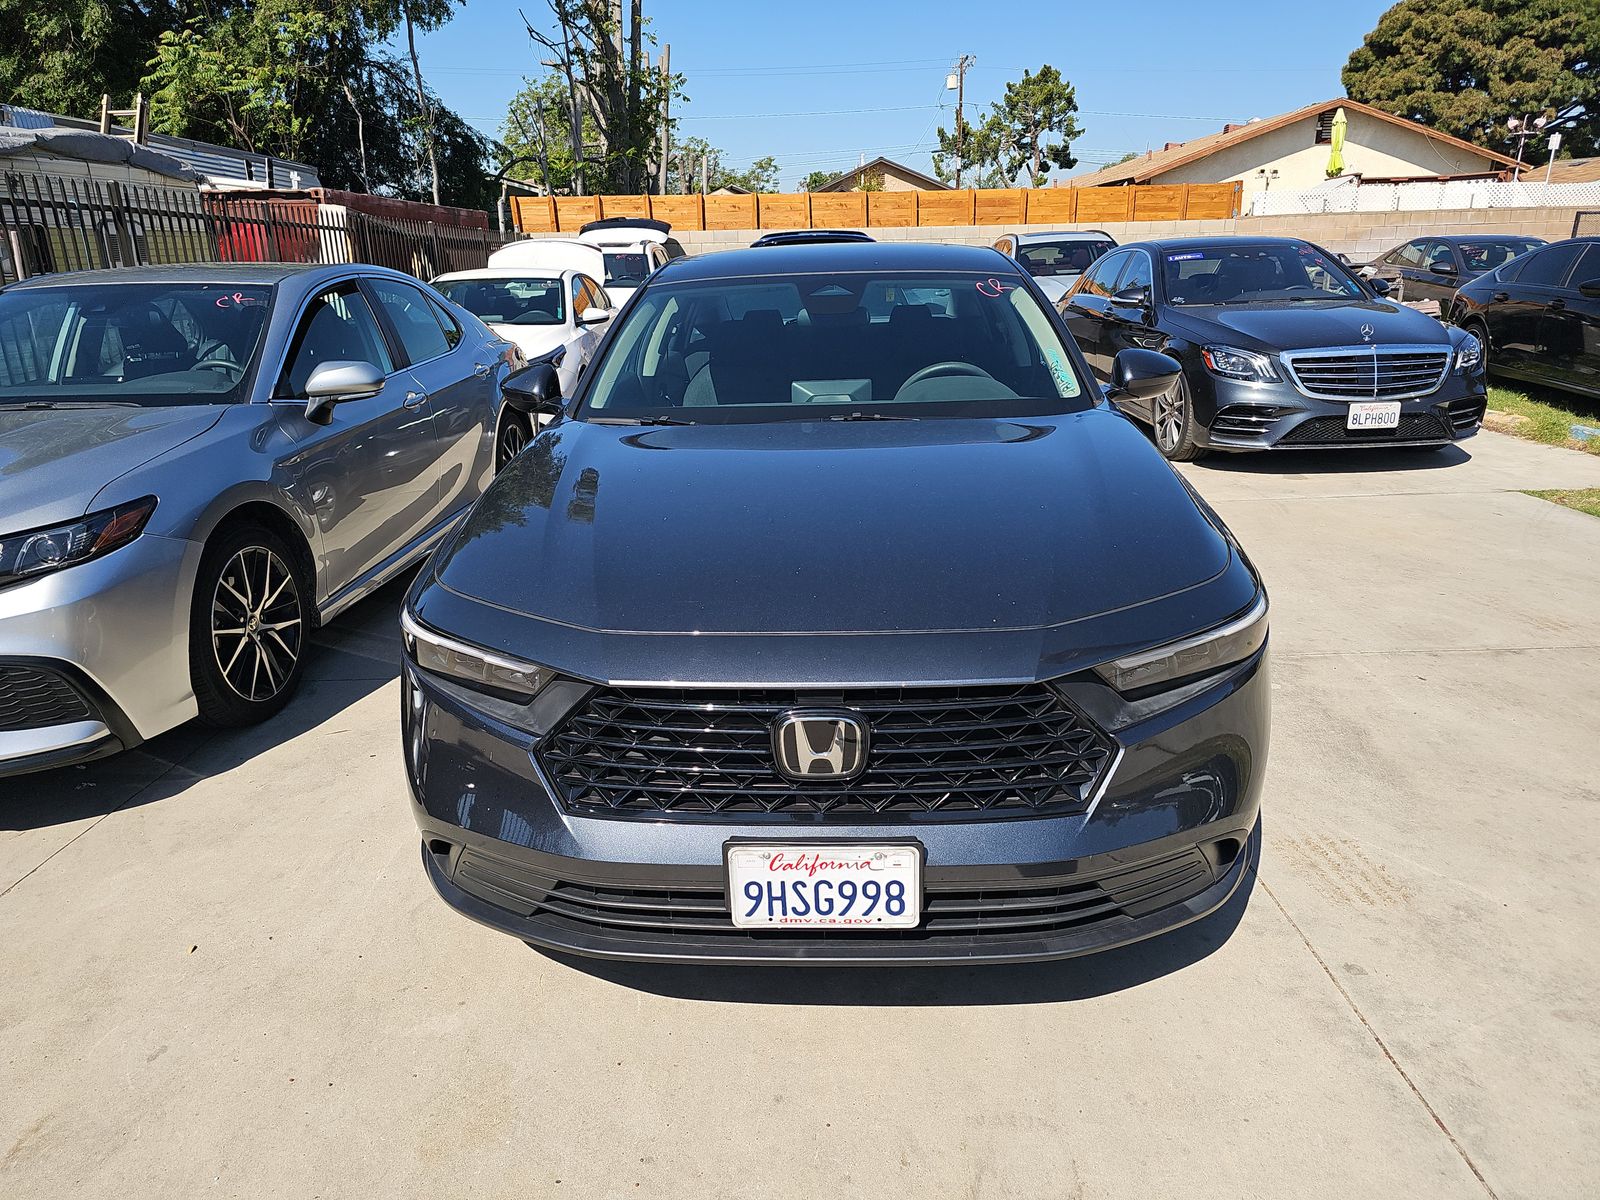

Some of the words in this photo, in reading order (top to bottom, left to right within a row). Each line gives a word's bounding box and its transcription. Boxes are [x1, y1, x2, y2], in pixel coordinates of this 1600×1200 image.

[1351, 412, 1396, 425] 8LPH800
[769, 852, 884, 877] California
[743, 879, 906, 917] 9HSG998
